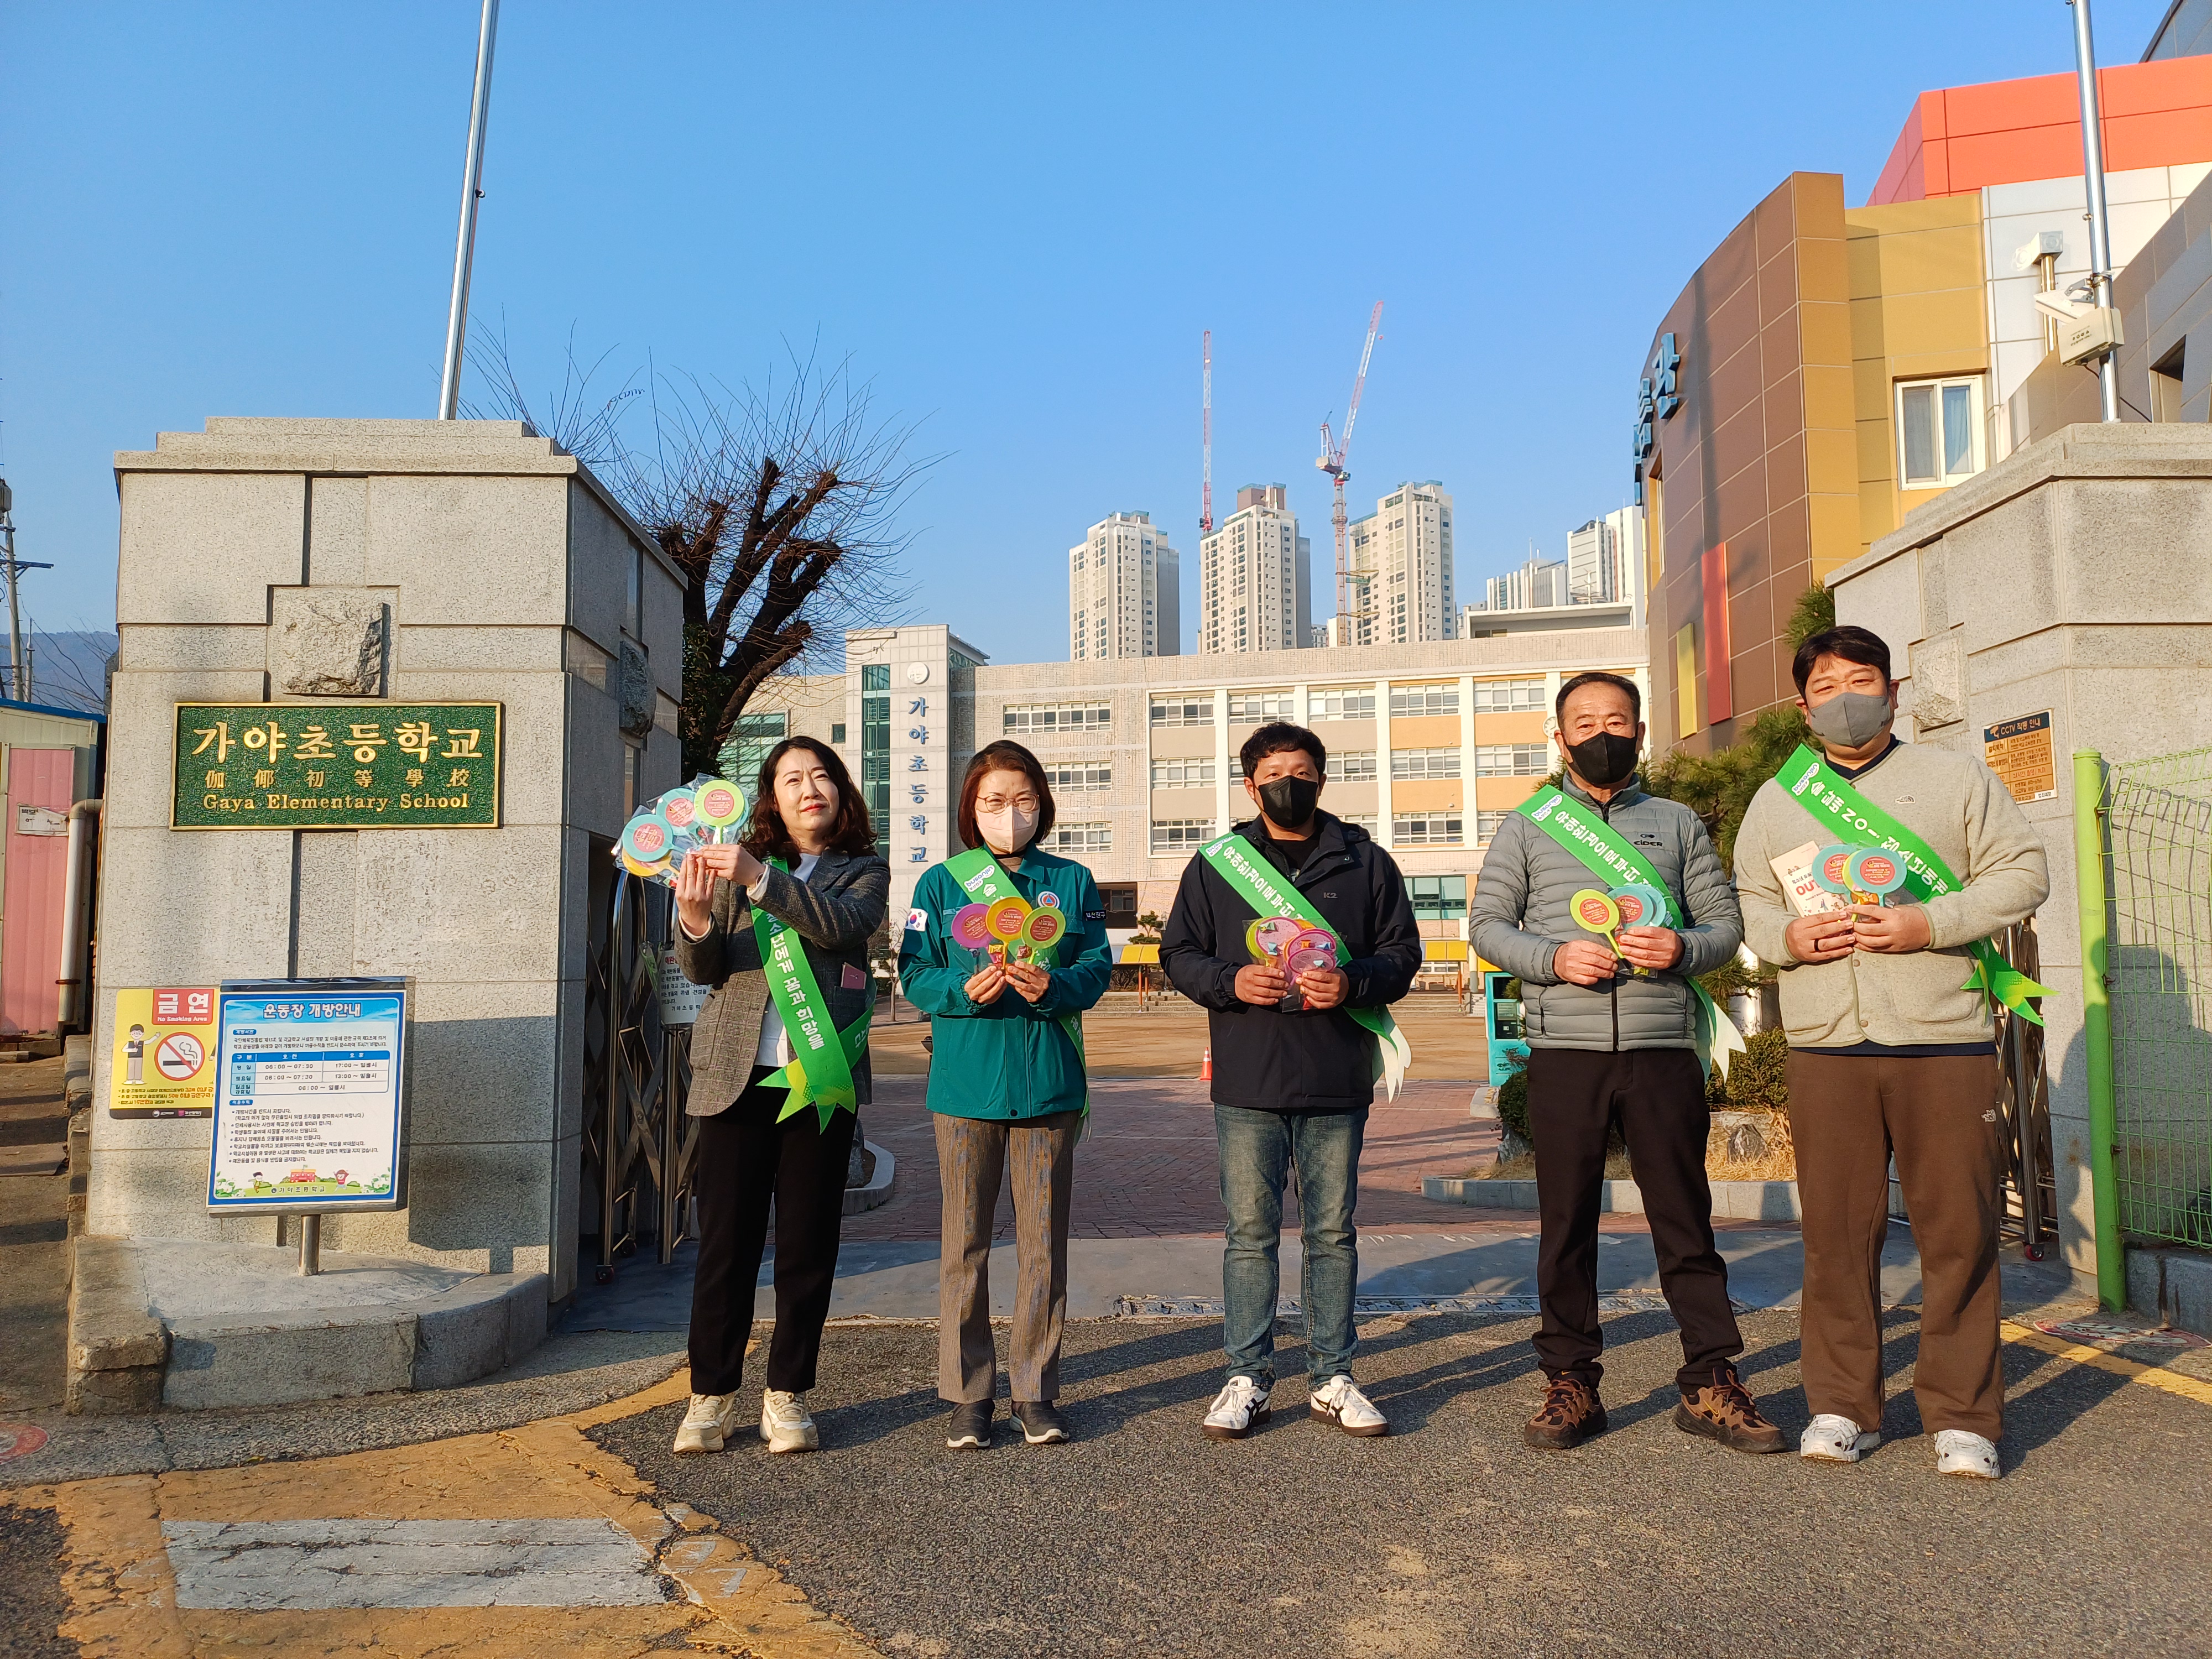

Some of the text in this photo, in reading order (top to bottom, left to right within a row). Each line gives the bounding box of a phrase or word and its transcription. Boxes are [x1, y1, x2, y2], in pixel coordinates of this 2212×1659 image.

[191, 721, 483, 764] 가야초등학교
[2001, 724, 2016, 735] CCTV
[908, 697, 929, 863] 가야초등학교
[1793, 764, 1818, 791] busanjin
[203, 793, 469, 812] Gaya Elementary School
[1533, 796, 1561, 817] busanjin
[1840, 806, 1880, 839] NO!
[1555, 810, 1641, 882] 유해환경으로부터
[966, 866, 994, 887] busanjin
[1223, 845, 1295, 916] 유해환경으로부터
[263, 1002, 362, 1019] 운동장 개방안내
[782, 978, 807, 1007] 꿈과
[795, 1009, 826, 1051] 희망을
